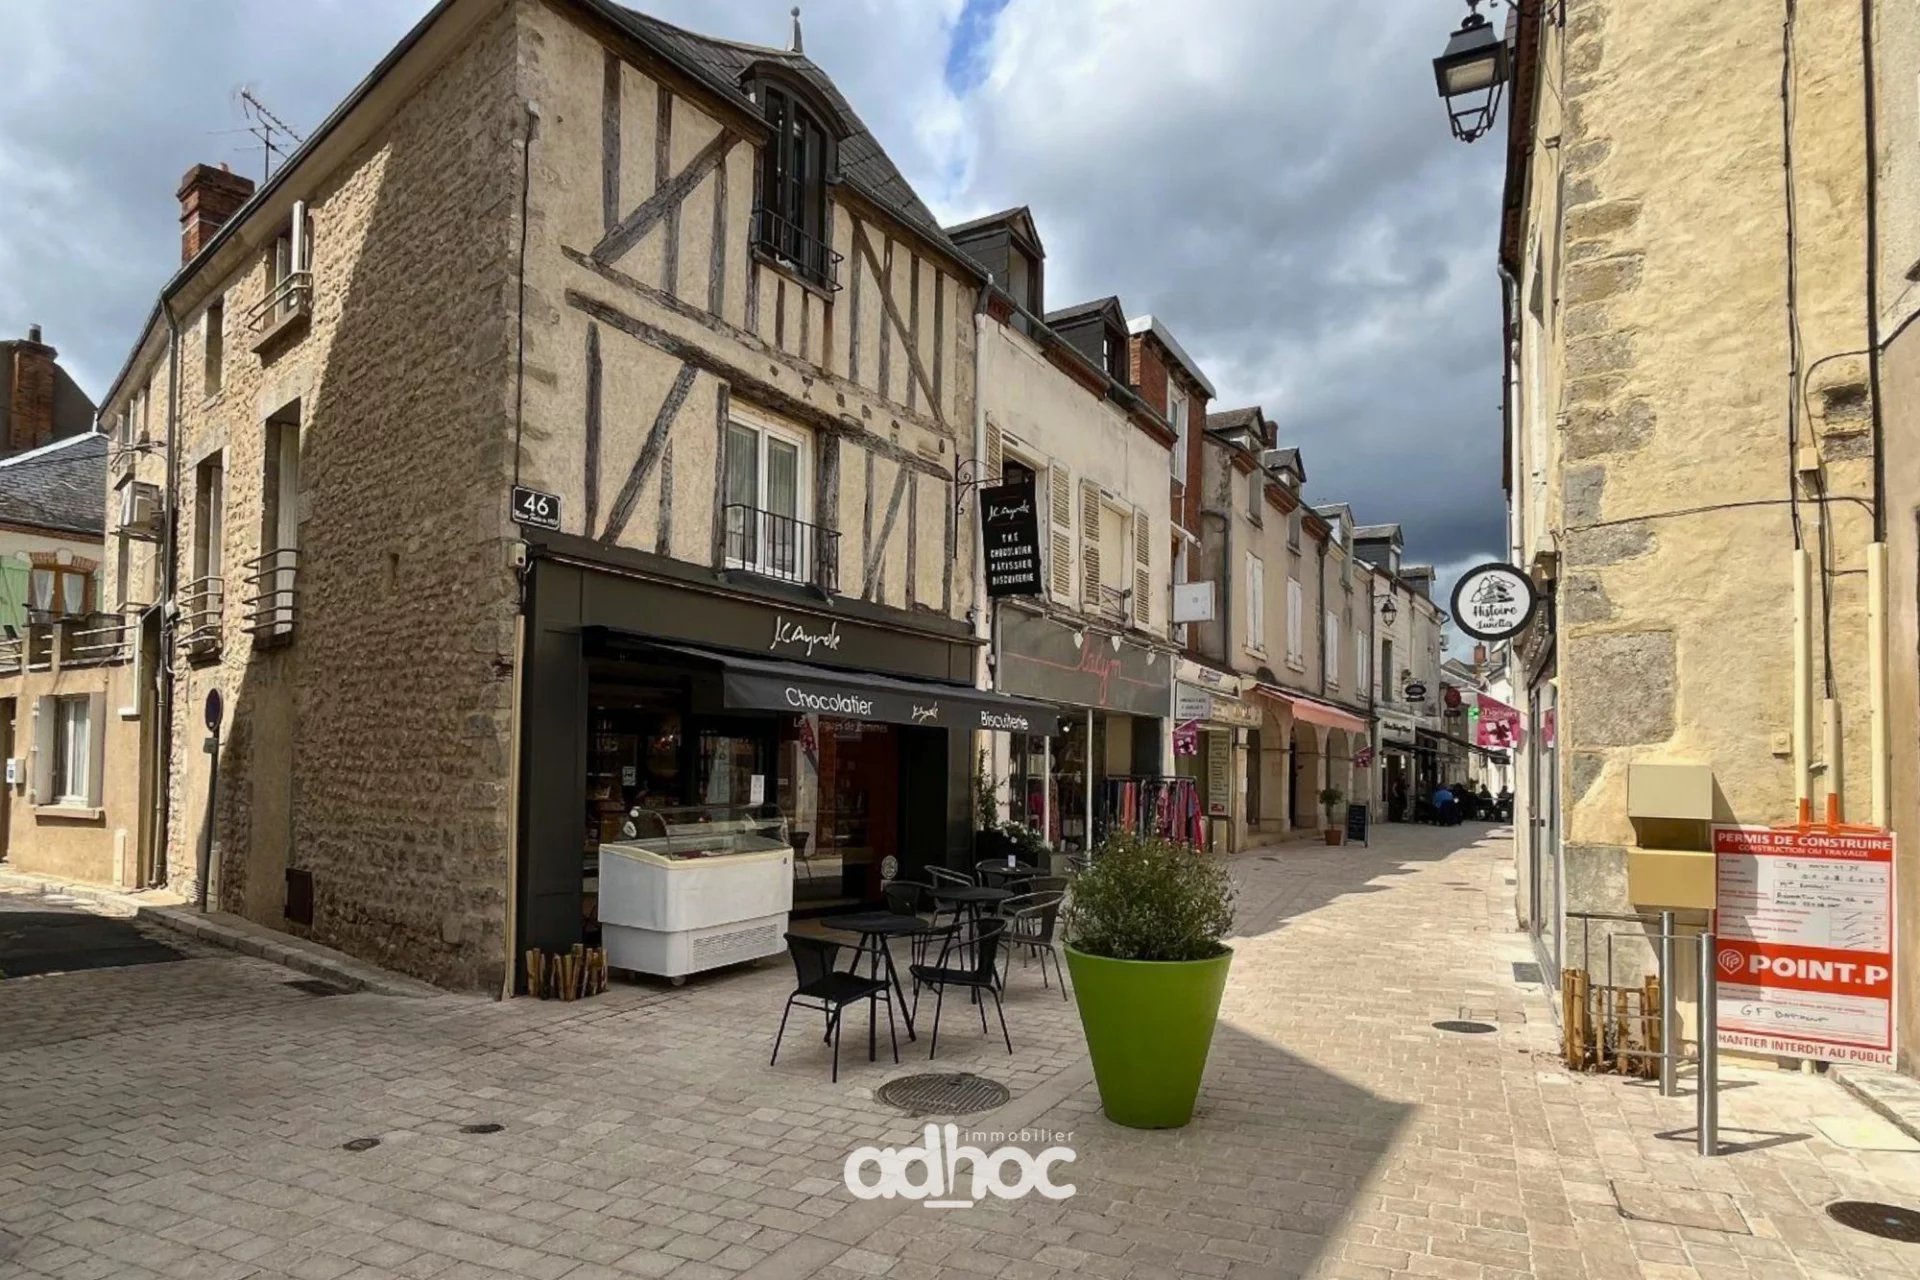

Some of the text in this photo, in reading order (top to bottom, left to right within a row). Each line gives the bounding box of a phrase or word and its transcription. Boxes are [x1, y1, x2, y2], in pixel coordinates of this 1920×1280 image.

[523, 493, 549, 516] 46
[1473, 604, 1517, 617] Histoire
[785, 687, 874, 716] Chocolatier
[980, 710, 1029, 730] Biscuiterie
[1718, 832, 1892, 850] PERMIS DE CONSTRUIRE
[1738, 844, 1869, 858] CONSTRUCTION OU TRAVAUX
[1749, 954, 1889, 985] POINT.P
[1718, 1034, 1893, 1065] HANTIER INTERDIT AU PUBLIC
